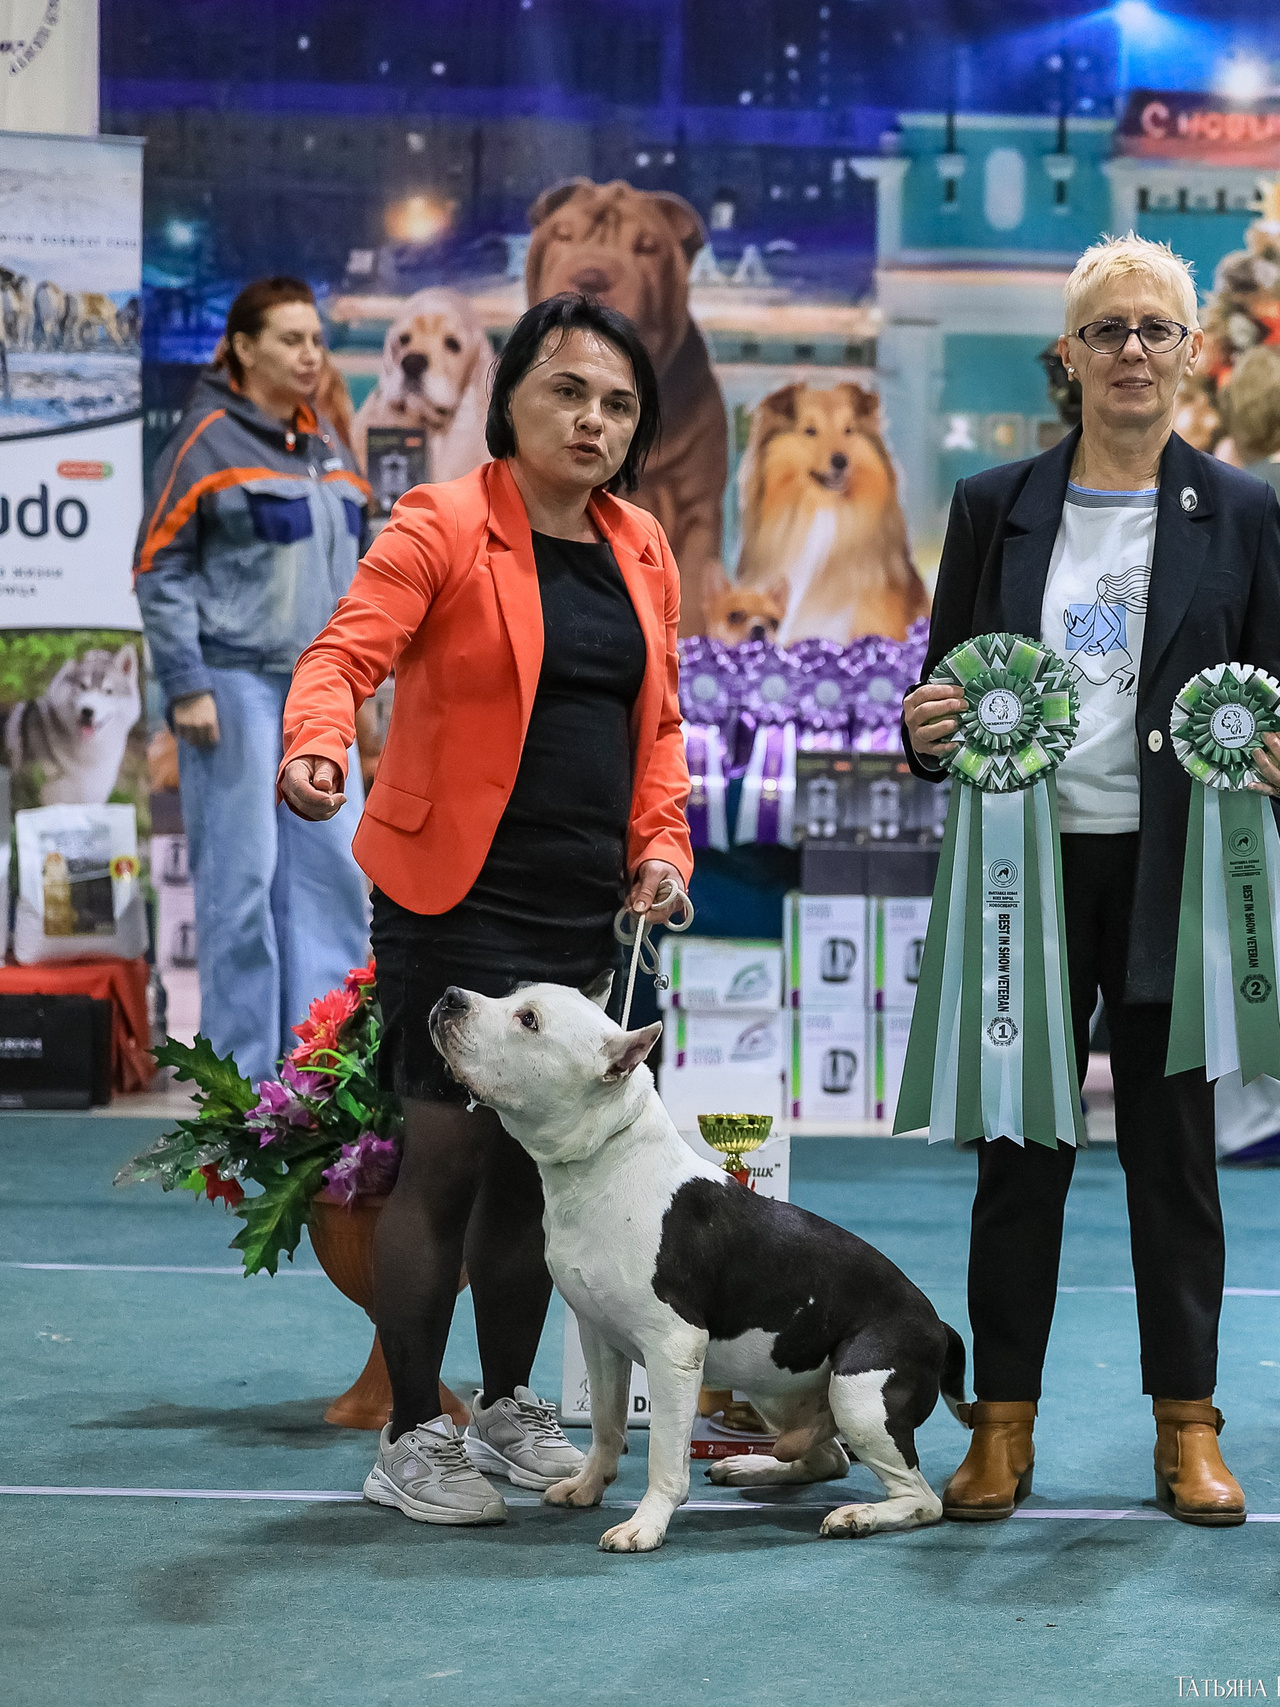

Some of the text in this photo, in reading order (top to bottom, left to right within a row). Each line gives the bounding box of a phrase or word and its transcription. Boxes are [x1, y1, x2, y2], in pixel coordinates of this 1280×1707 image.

[1243, 885, 1260, 969] BEST IN SHOW VETERAN
[997, 913, 1011, 1012] BEST IN SHOW VETERAN
[1250, 981, 1262, 996] 2
[998, 1024, 1008, 1039] 1
